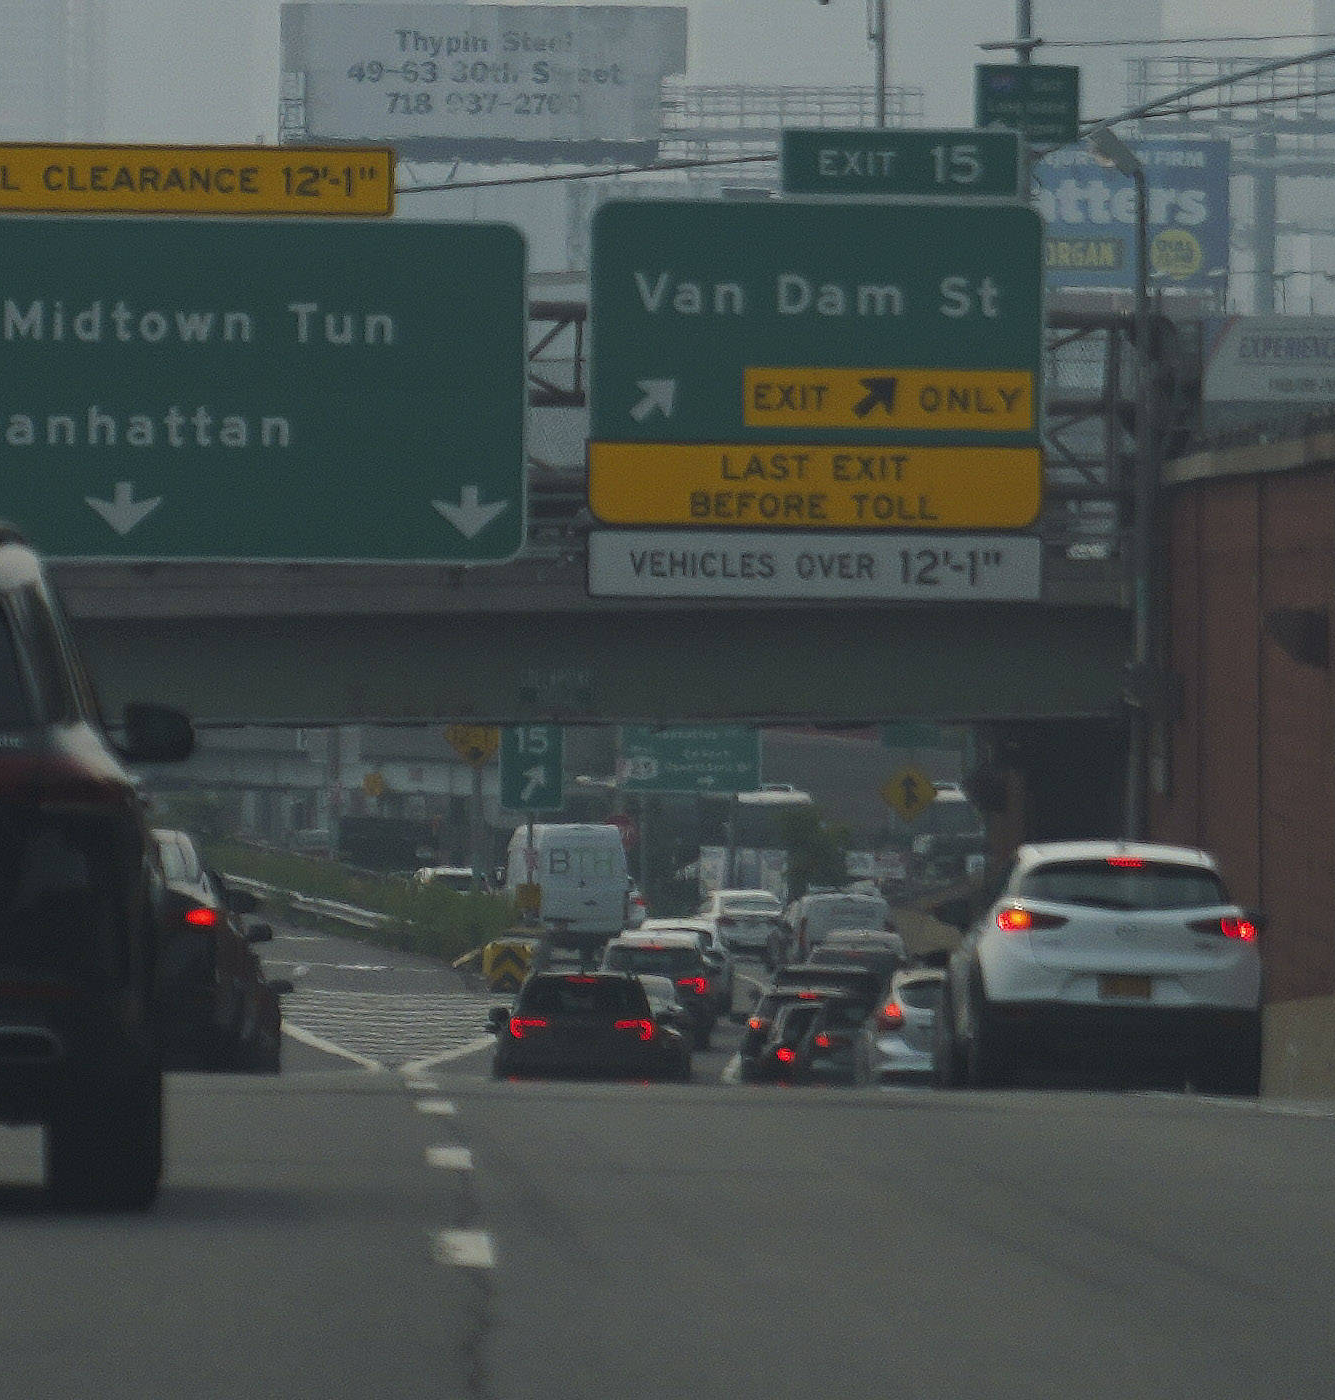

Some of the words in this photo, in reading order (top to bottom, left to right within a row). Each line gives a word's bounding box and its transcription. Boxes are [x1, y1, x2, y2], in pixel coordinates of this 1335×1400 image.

[395, 29, 489, 57] Thypin
[385, 91, 434, 116] 718
[818, 149, 898, 177] EXIT
[930, 145, 983, 184] 15
[41, 165, 261, 195] CLEARANCE
[633, 271, 743, 315] Van
[777, 273, 904, 317] Dam
[939, 275, 1000, 318] St
[2, 299, 253, 344] Midtown
[287, 301, 397, 345] Tun
[752, 383, 829, 413] EXIT
[918, 385, 1025, 415] ONLY
[720, 453, 809, 482] LAST
[832, 455, 910, 482] EXIT
[689, 491, 828, 521] BEFORE
[850, 492, 939, 522] TOLL
[629, 551, 776, 580] VEHICLES
[796, 552, 874, 581] OVER
[514, 726, 549, 755] 15
[548, 846, 615, 877] BTH
